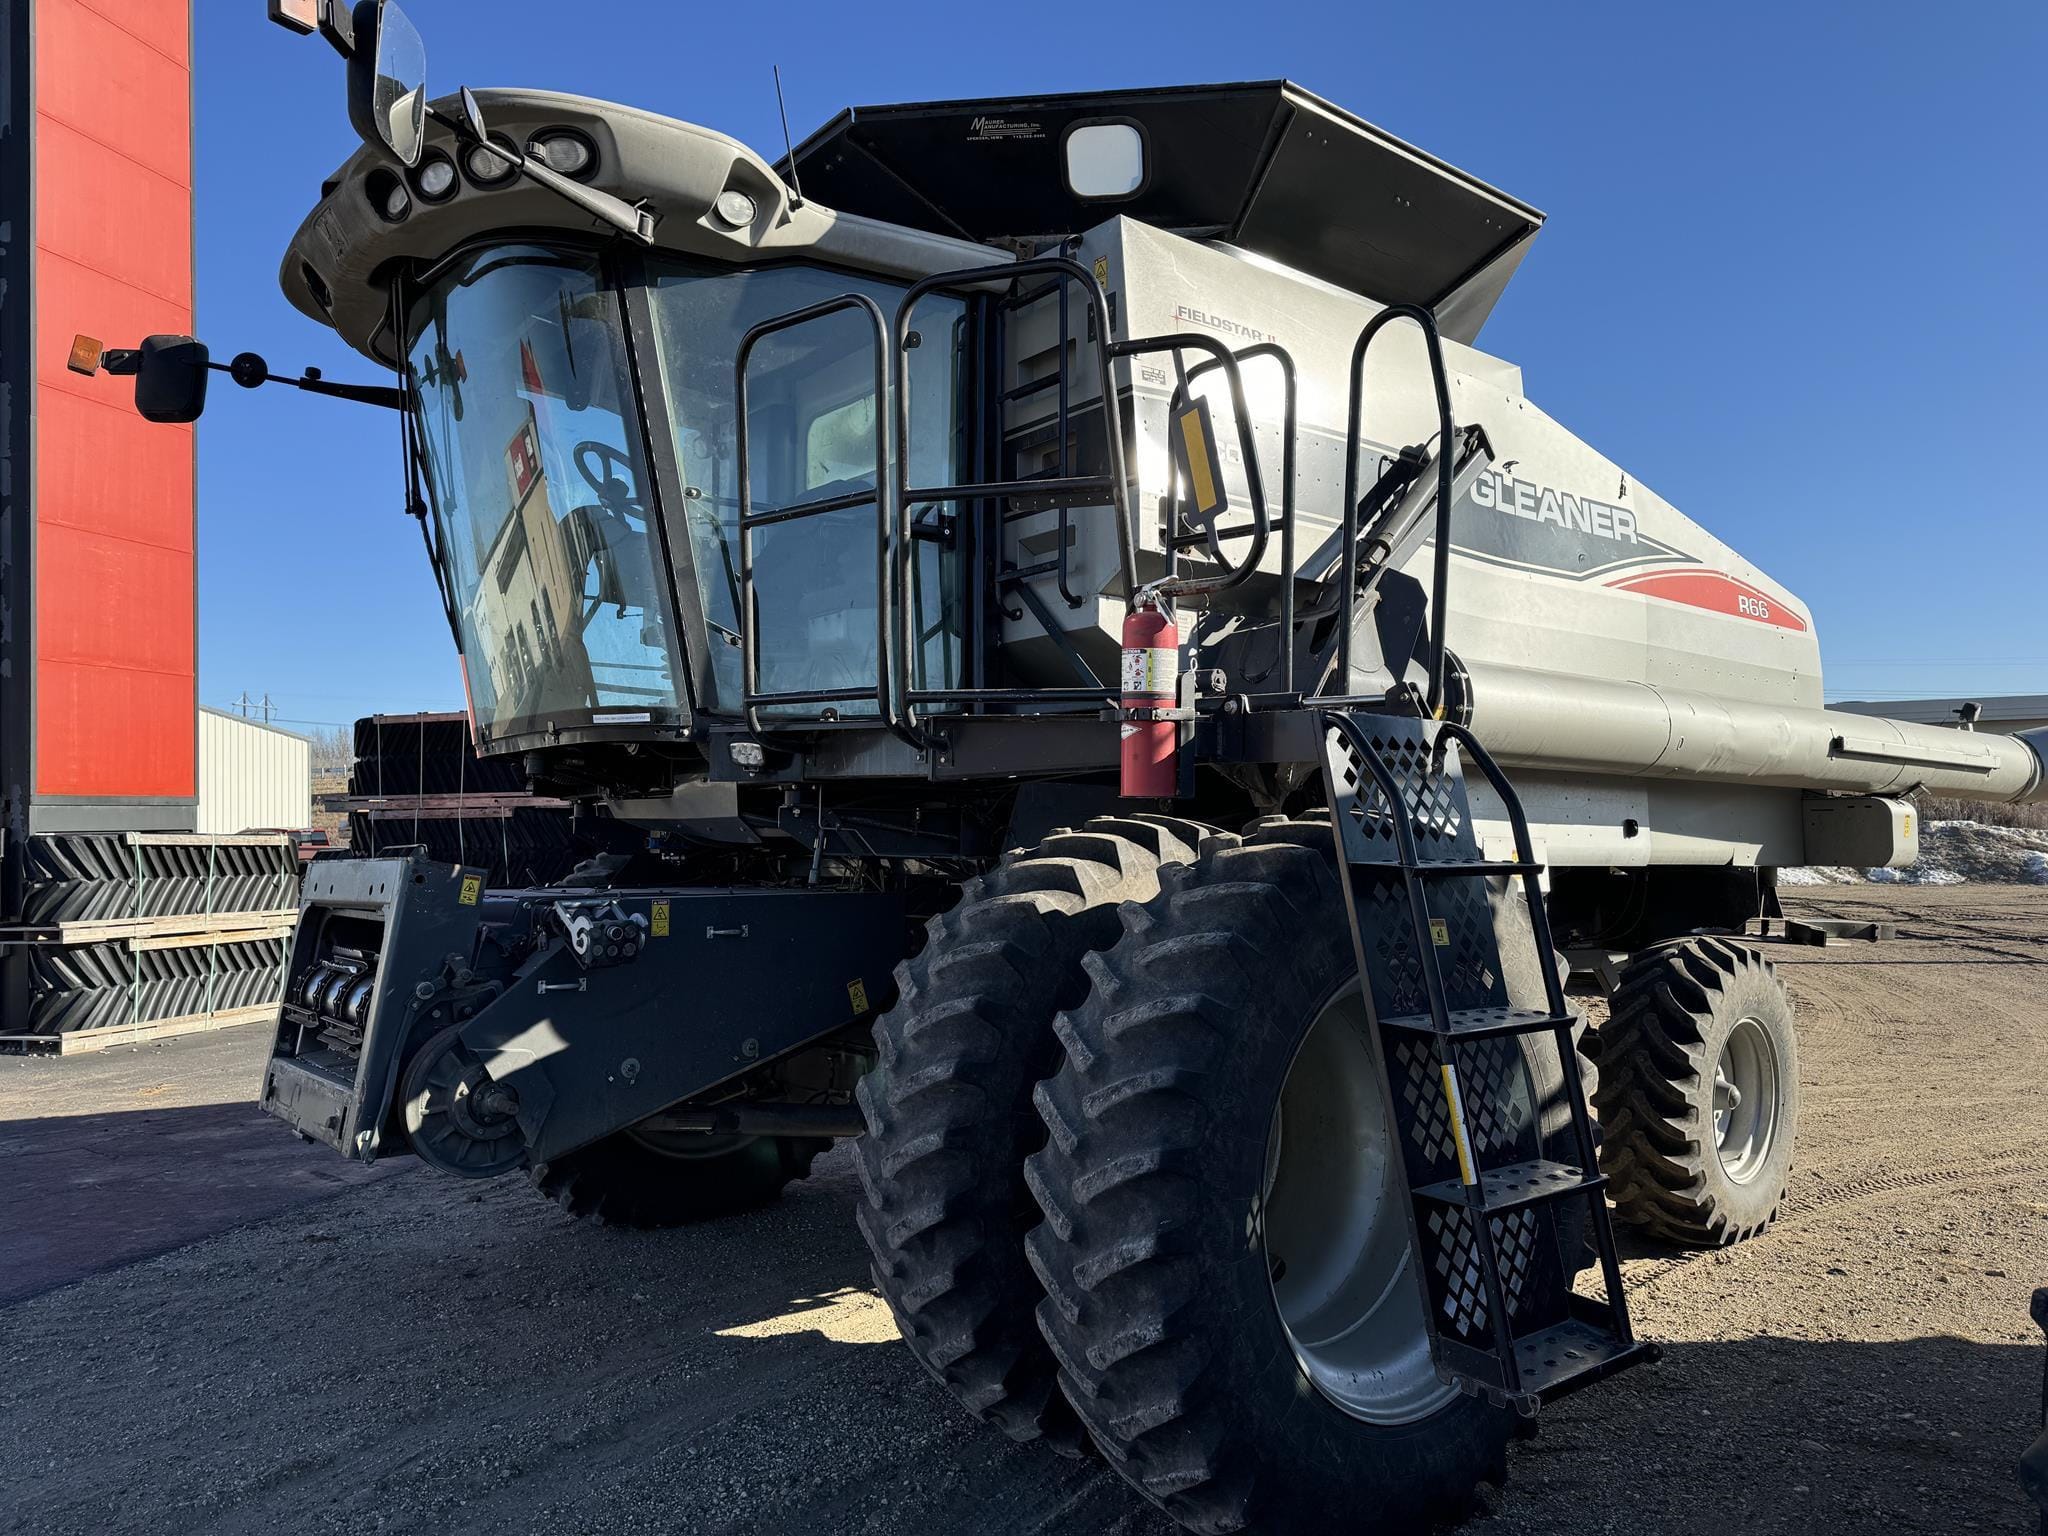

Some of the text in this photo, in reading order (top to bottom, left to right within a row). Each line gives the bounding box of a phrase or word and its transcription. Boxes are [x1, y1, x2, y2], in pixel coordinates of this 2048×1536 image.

[1177, 305, 1263, 341] FIELDSTAR
[1469, 471, 1639, 544] GLEANER
[1738, 594, 1770, 619] R66
